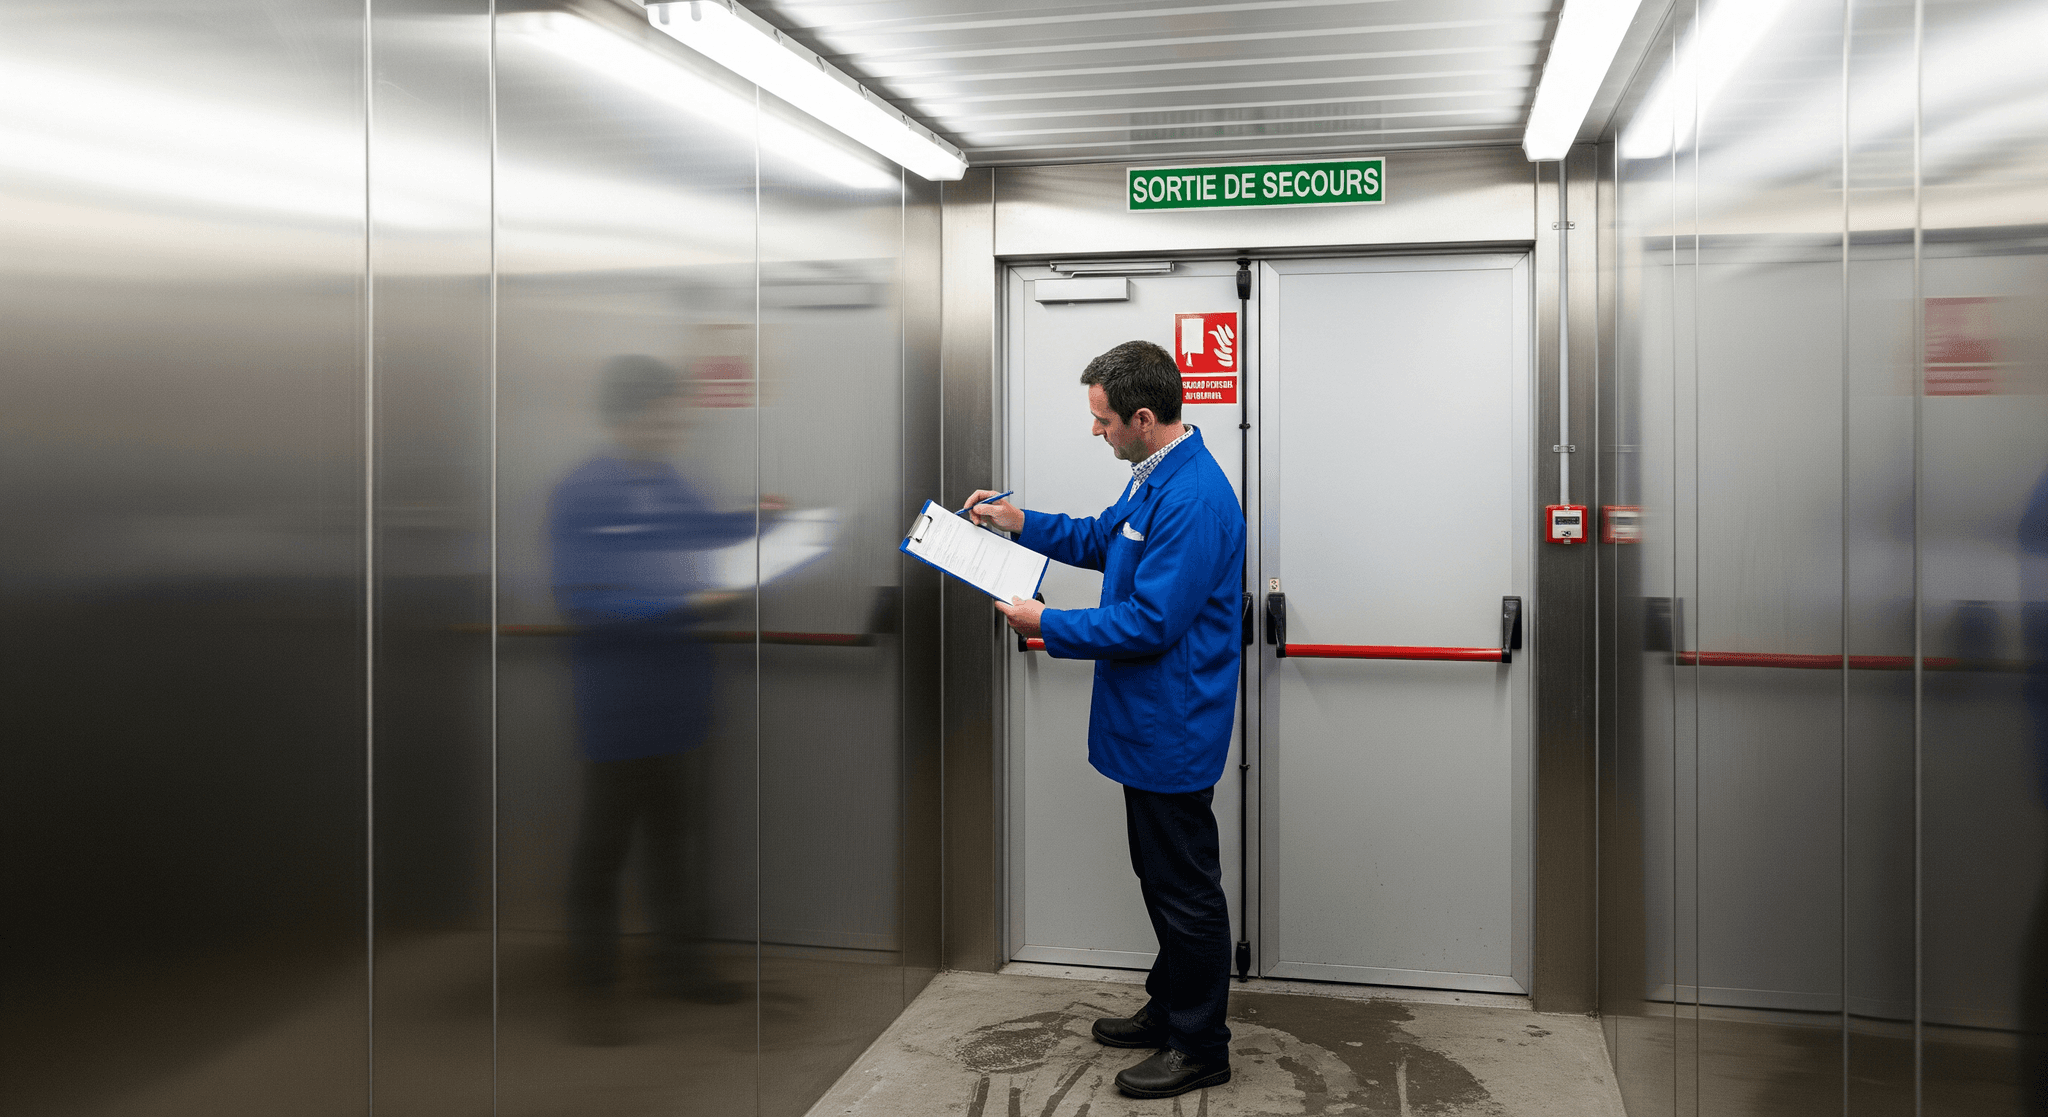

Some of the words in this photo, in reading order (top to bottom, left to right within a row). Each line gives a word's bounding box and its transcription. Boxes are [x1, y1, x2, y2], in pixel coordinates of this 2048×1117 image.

[1132, 174, 1217, 203] SORTIE
[1224, 172, 1256, 200] DE
[1262, 167, 1379, 199] SECOURS
